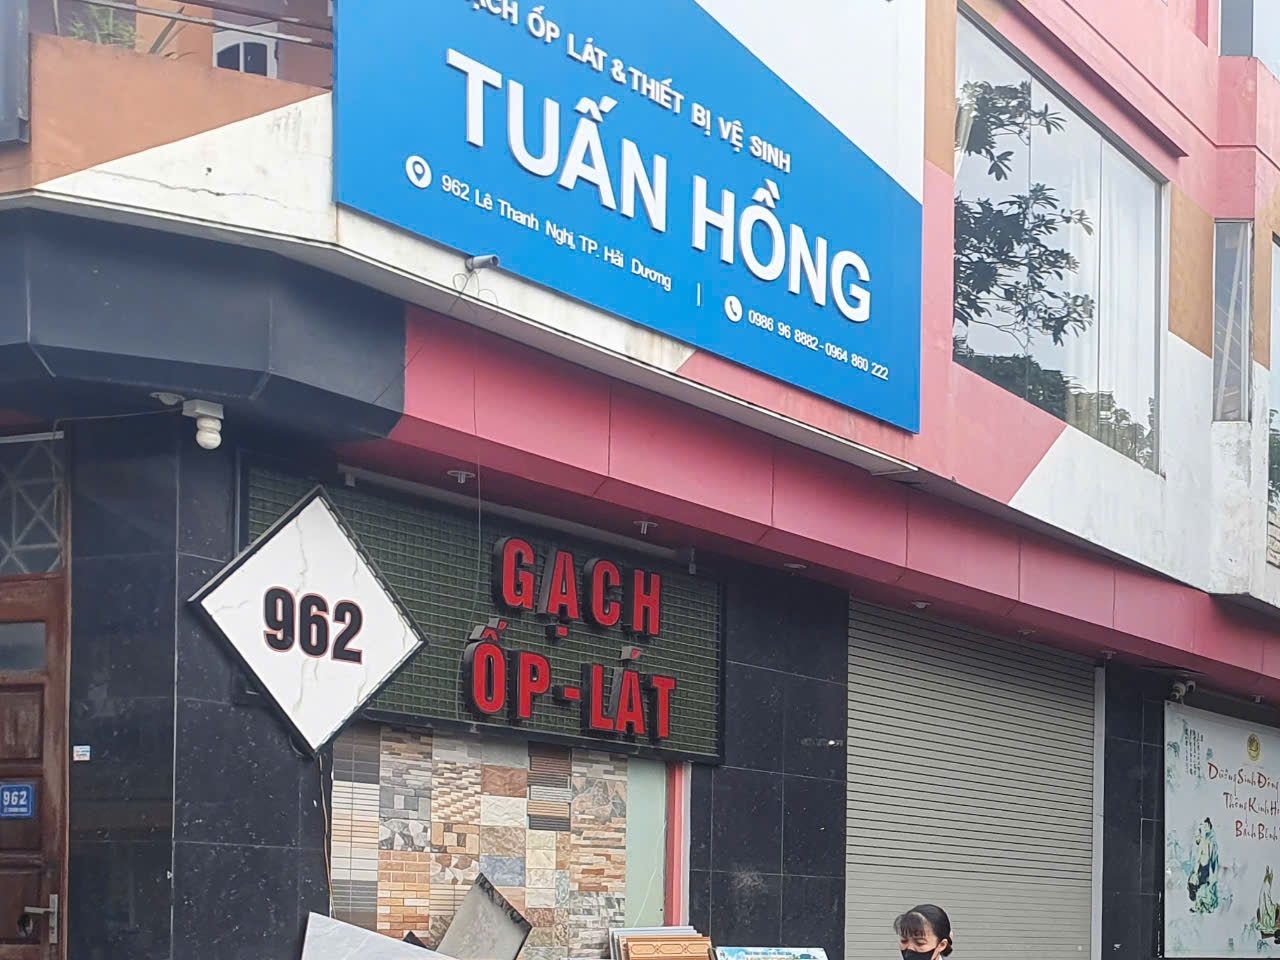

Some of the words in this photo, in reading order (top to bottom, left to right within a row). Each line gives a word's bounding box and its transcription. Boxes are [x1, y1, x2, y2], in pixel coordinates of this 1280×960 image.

[527, 6, 561, 43] ỐP
[567, 33, 608, 72] LÁT
[627, 66, 685, 114] THIẾT
[691, 102, 711, 137] BỊ
[718, 117, 744, 153] VỆ
[749, 136, 791, 174] SINH
[441, 174, 470, 202] 962
[474, 188, 493, 211] Lê
[497, 199, 539, 231] Thanh
[604, 246, 624, 269] Hải
[631, 258, 672, 291] Dương
[446, 48, 667, 233] TUẤN
[692, 172, 871, 323] HỒNG
[748, 309, 774, 332] 0986
[777, 321, 791, 339] 96
[851, 353, 868, 371] 860
[871, 362, 889, 381] 222
[263, 585, 363, 665] 962
[499, 537, 661, 637] GẠCH
[3, 791, 27, 805] 962
